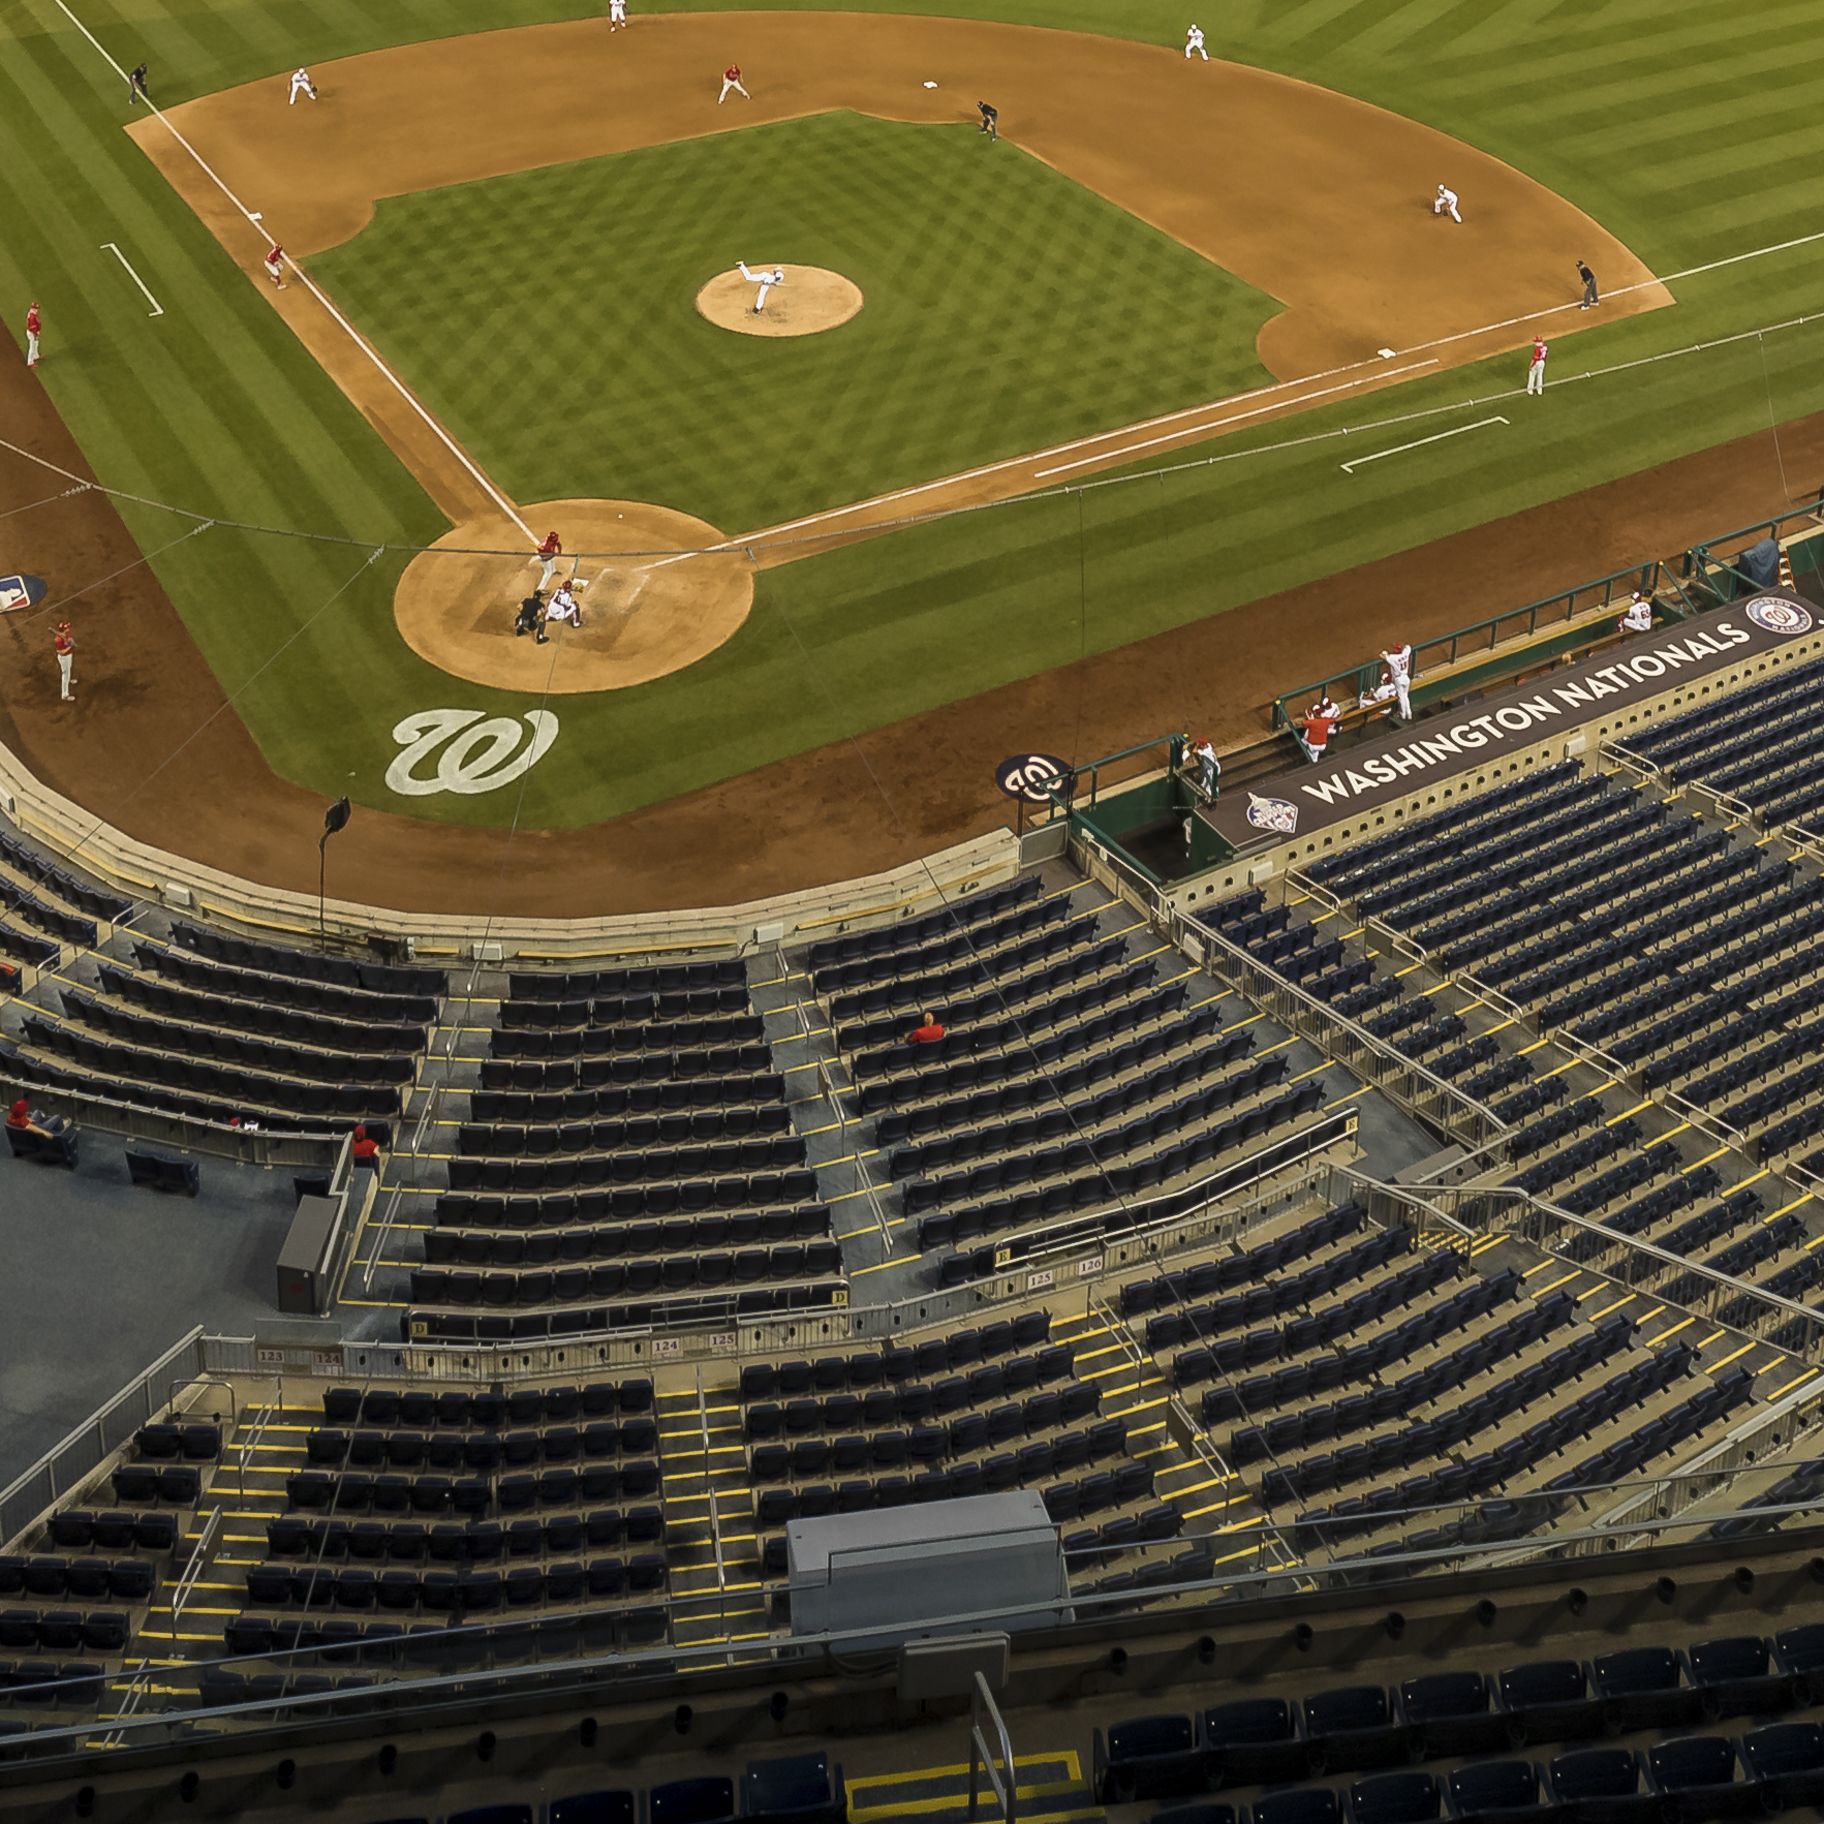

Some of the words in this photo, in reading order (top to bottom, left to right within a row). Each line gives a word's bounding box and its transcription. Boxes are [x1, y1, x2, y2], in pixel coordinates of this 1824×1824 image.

[1301, 682, 1560, 805] WASHINGTON
[1553, 623, 1751, 711] NATIONALS
[384, 708, 561, 796] W
[1005, 756, 1064, 802] W
[998, 1249, 1009, 1262] E
[1080, 1258, 1103, 1273] 126
[1029, 1273, 1053, 1287] 125
[834, 1292, 846, 1303] D
[414, 1323, 425, 1334] D
[654, 1339, 678, 1352] 124
[711, 1334, 735, 1347] 125
[260, 1350, 283, 1362] 123
[317, 1352, 341, 1364] 124
